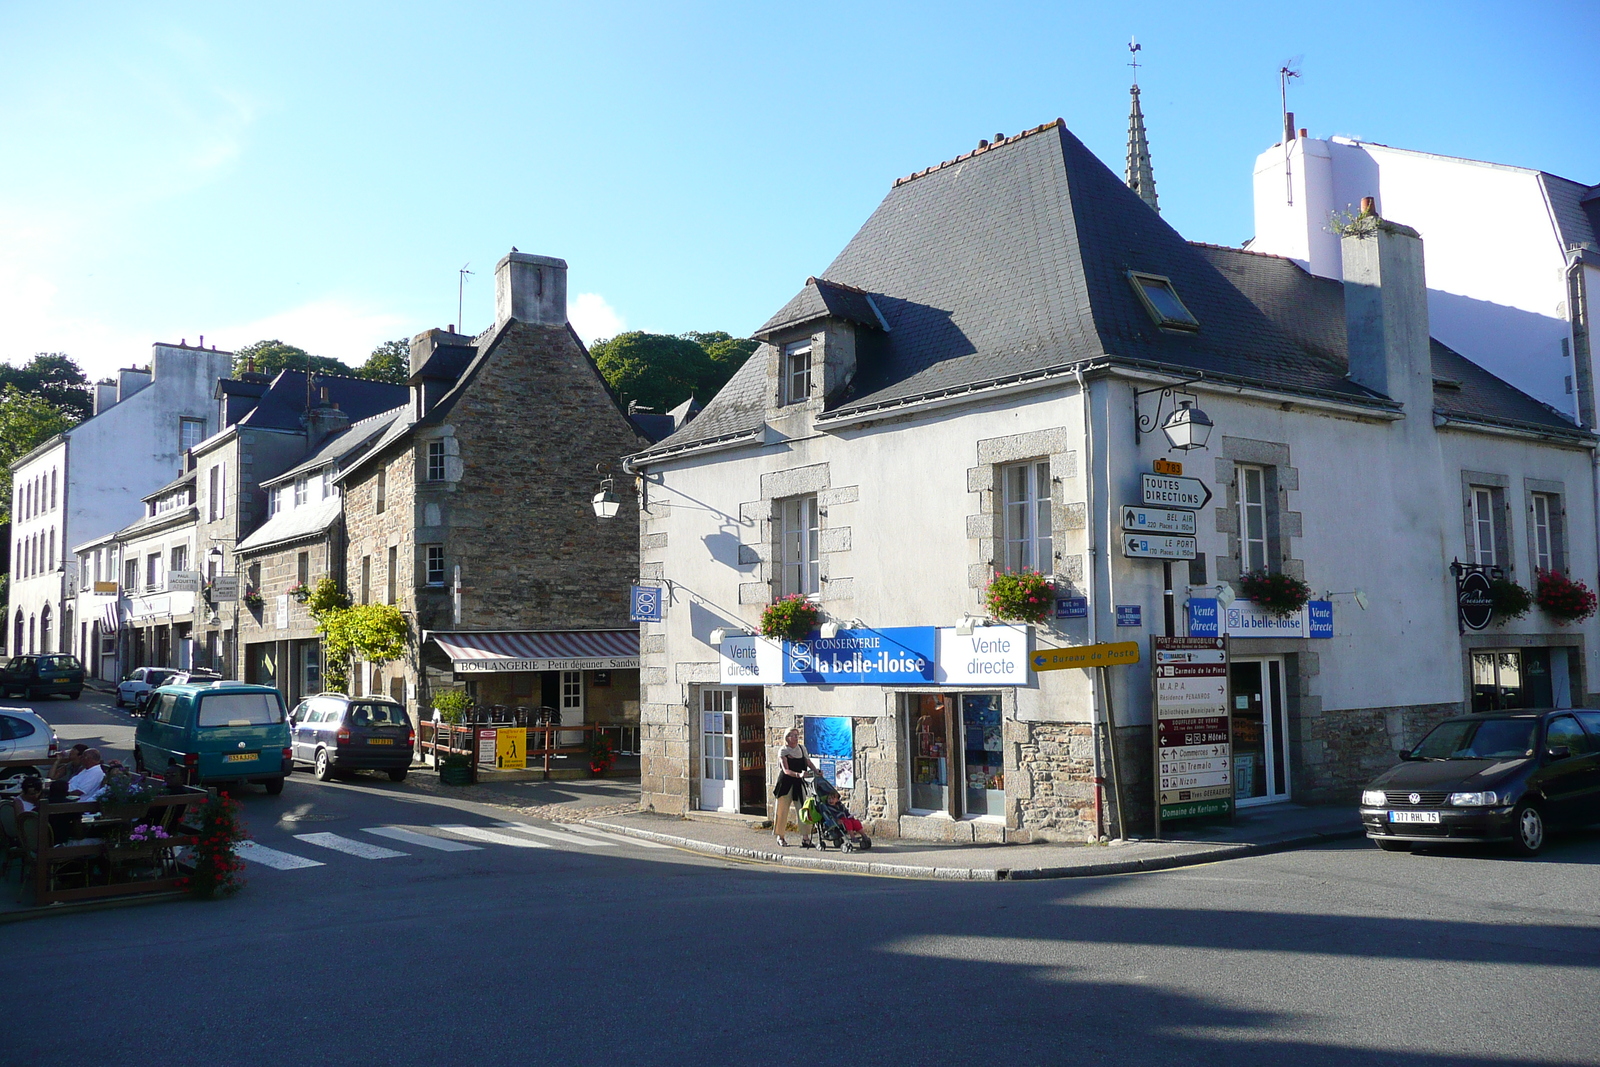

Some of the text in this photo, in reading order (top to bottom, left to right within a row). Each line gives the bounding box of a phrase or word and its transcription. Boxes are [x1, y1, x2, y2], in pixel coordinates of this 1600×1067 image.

[1156, 462, 1180, 473] D 783
[1146, 478, 1180, 490] TOUTES
[1146, 490, 1199, 504] DIRECTIONS
[1166, 514, 1193, 522] BEL AIR
[1193, 605, 1214, 616] Vente
[1312, 608, 1330, 618] Vente
[1191, 619, 1217, 631] directe
[1241, 615, 1300, 628] la belle-iloise
[1310, 619, 1332, 632] directe
[815, 638, 880, 650] CONSERVERIE
[972, 638, 1011, 653] Vente
[730, 645, 757, 658] Vente
[1053, 655, 1085, 663] Bureau
[1108, 649, 1134, 658] Poste
[461, 661, 539, 671] BOULANGERIE
[548, 661, 568, 669] Petit
[570, 660, 603, 670] déjeuner
[816, 651, 925, 673] la belle-iloise
[967, 658, 1014, 674] directe
[728, 662, 759, 676] directe
[1208, 732, 1227, 741] Hôtels
[1188, 761, 1212, 770] Tremalo
[1162, 808, 1187, 817] Domaine
[1396, 813, 1436, 821] 377 RHL 75
